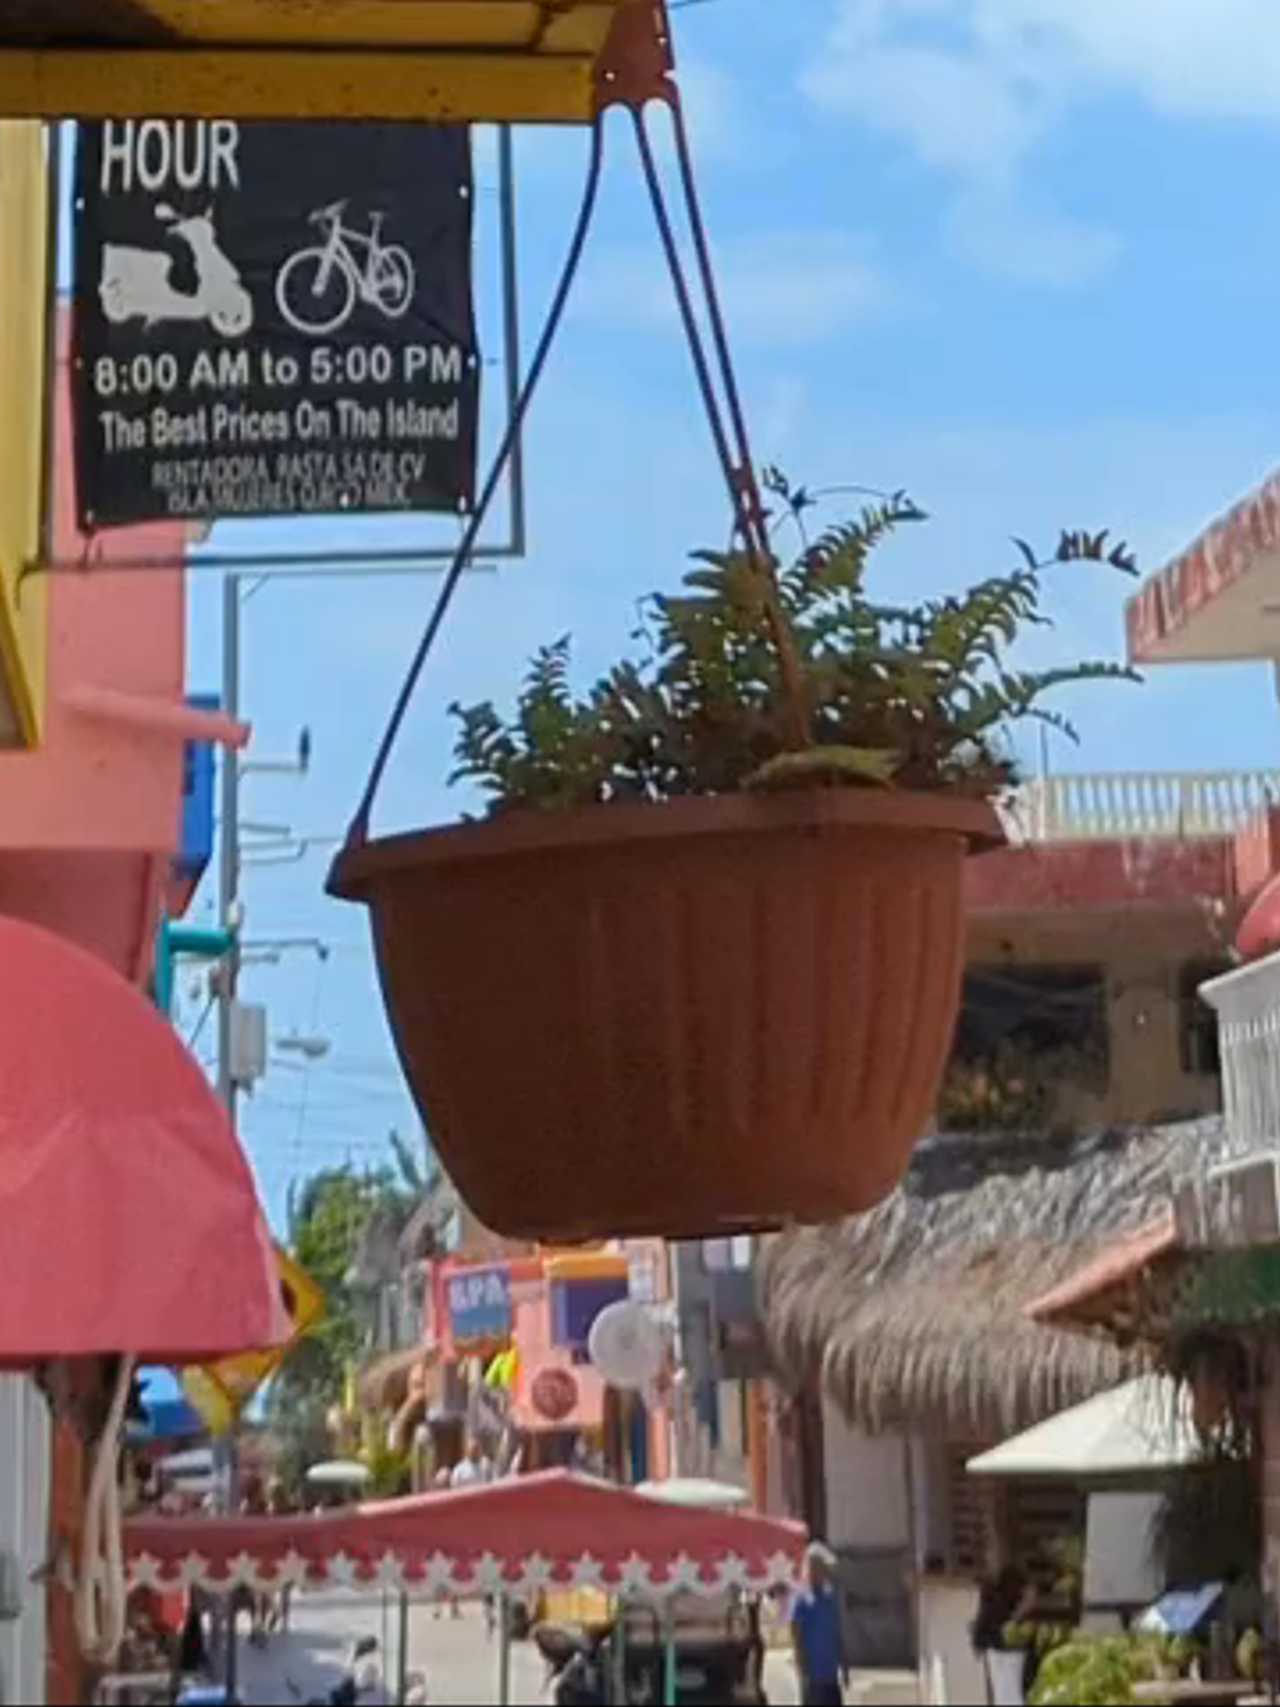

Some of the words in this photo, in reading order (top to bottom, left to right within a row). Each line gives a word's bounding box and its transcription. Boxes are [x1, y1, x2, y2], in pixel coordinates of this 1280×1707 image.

[101, 119, 241, 192] HOUR
[94, 355, 179, 395] 8:00
[189, 349, 250, 391] AM
[261, 348, 299, 384] to
[310, 345, 392, 383] 5:00
[403, 345, 462, 382] PM
[98, 410, 146, 452] The
[150, 404, 207, 448] Best
[212, 402, 290, 441] Prices
[295, 399, 331, 439] On
[335, 398, 381, 439] The
[386, 397, 459, 440] Island
